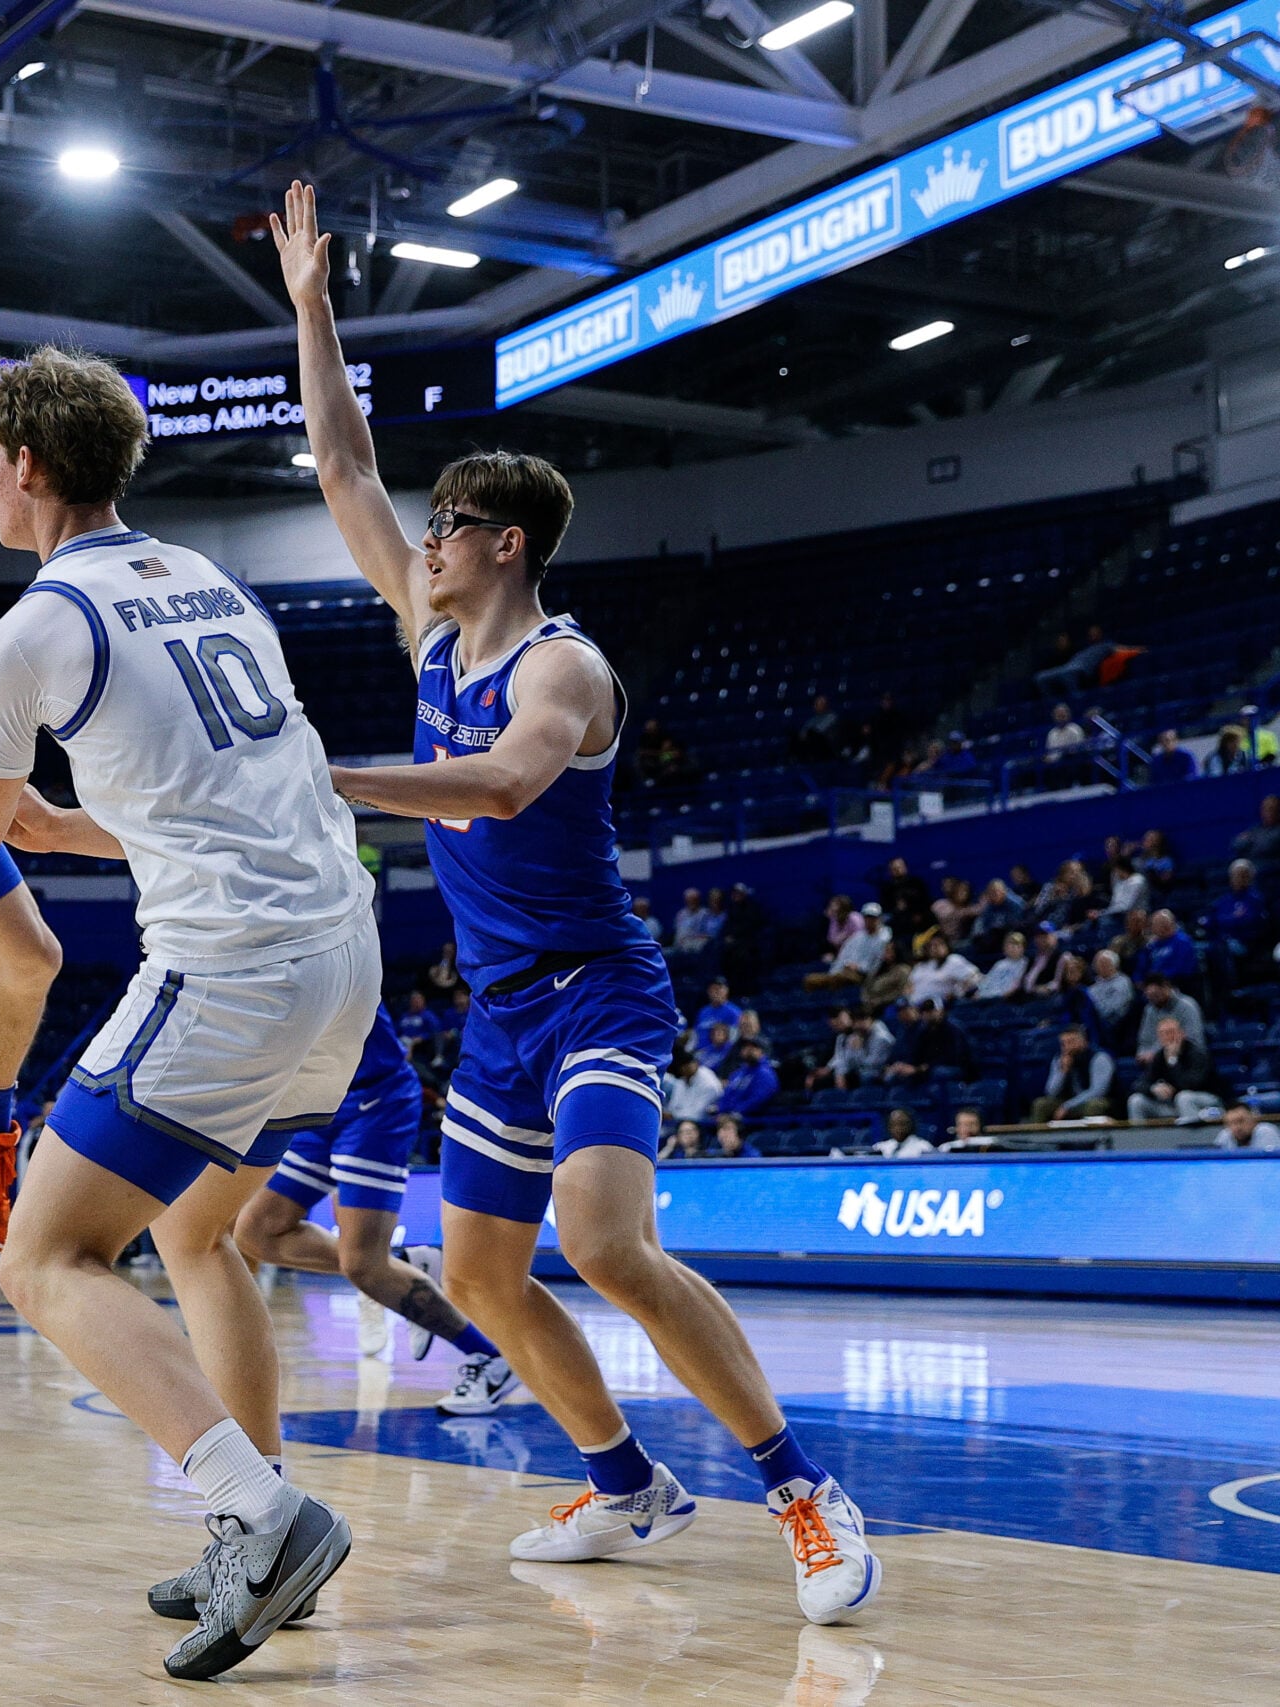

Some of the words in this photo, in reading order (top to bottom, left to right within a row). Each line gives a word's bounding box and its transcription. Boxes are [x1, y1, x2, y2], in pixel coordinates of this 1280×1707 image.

[1009, 100, 1096, 171] BUD
[722, 232, 790, 294] BUD
[791, 185, 891, 264] LIGHT
[497, 337, 550, 390] BUD
[551, 300, 631, 366] LIGHT
[148, 383, 197, 407] New
[201, 375, 286, 401] Orleans
[425, 386, 442, 411] F
[149, 412, 211, 437] Texas
[214, 401, 305, 431] A&M-Co
[113, 586, 245, 632] FALCONS
[163, 633, 287, 751] 10
[417, 699, 457, 735] BOIE
[885, 1189, 985, 1238] USAA
